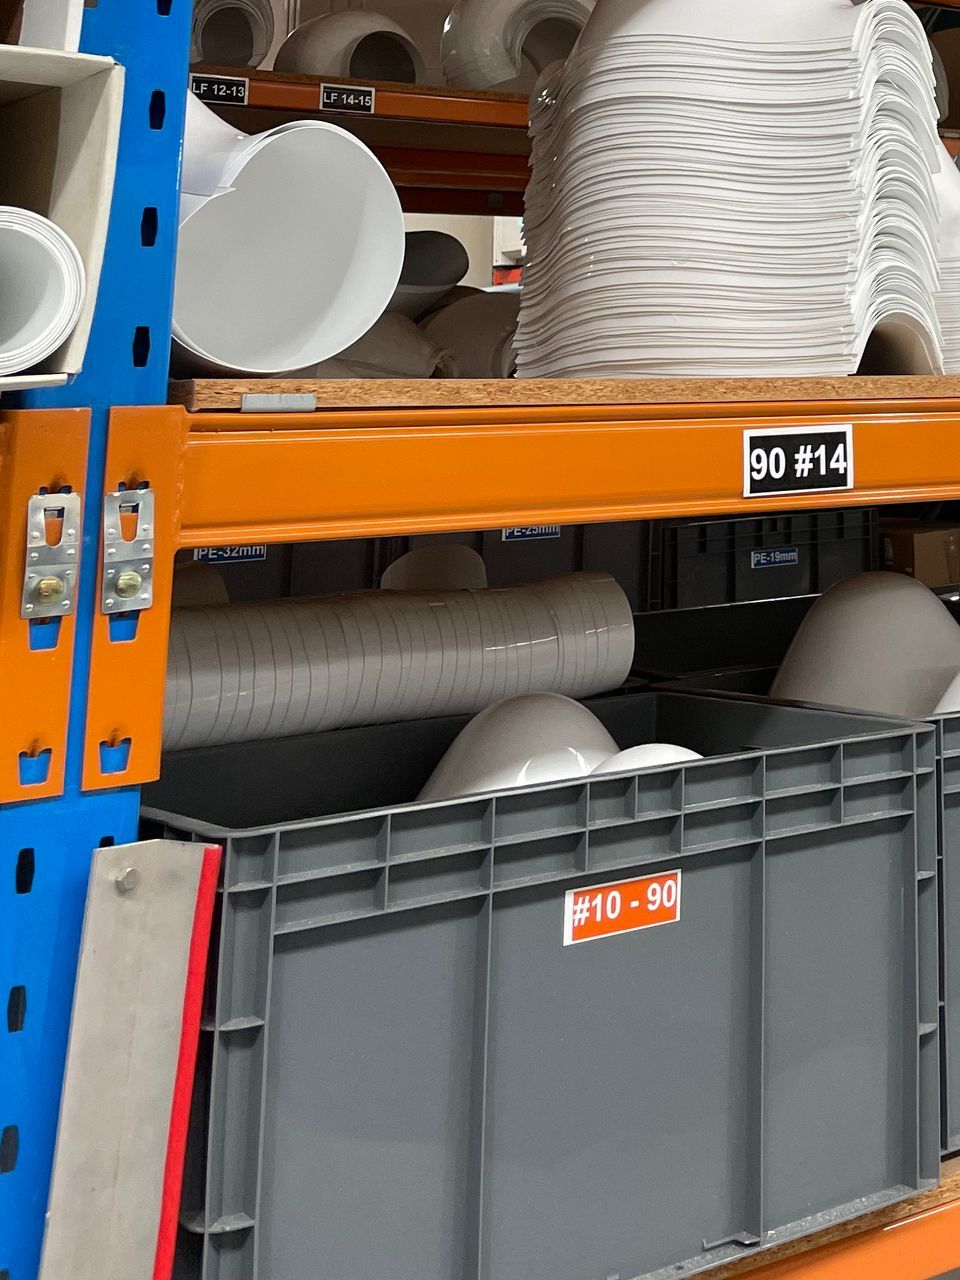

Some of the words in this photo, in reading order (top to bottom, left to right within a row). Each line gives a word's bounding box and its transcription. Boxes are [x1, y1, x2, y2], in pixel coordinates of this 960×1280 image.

[192, 83, 208, 94] LF
[212, 84, 245, 97] 12-13
[323, 92, 338, 103] LF
[341, 94, 372, 106] 14-15
[750, 447, 786, 480] 90
[795, 443, 847, 477] #14
[199, 544, 265, 559] PE-32mm
[754, 551, 797, 564] PE-19mm
[573, 890, 621, 930] #10
[647, 879, 677, 911] 90
